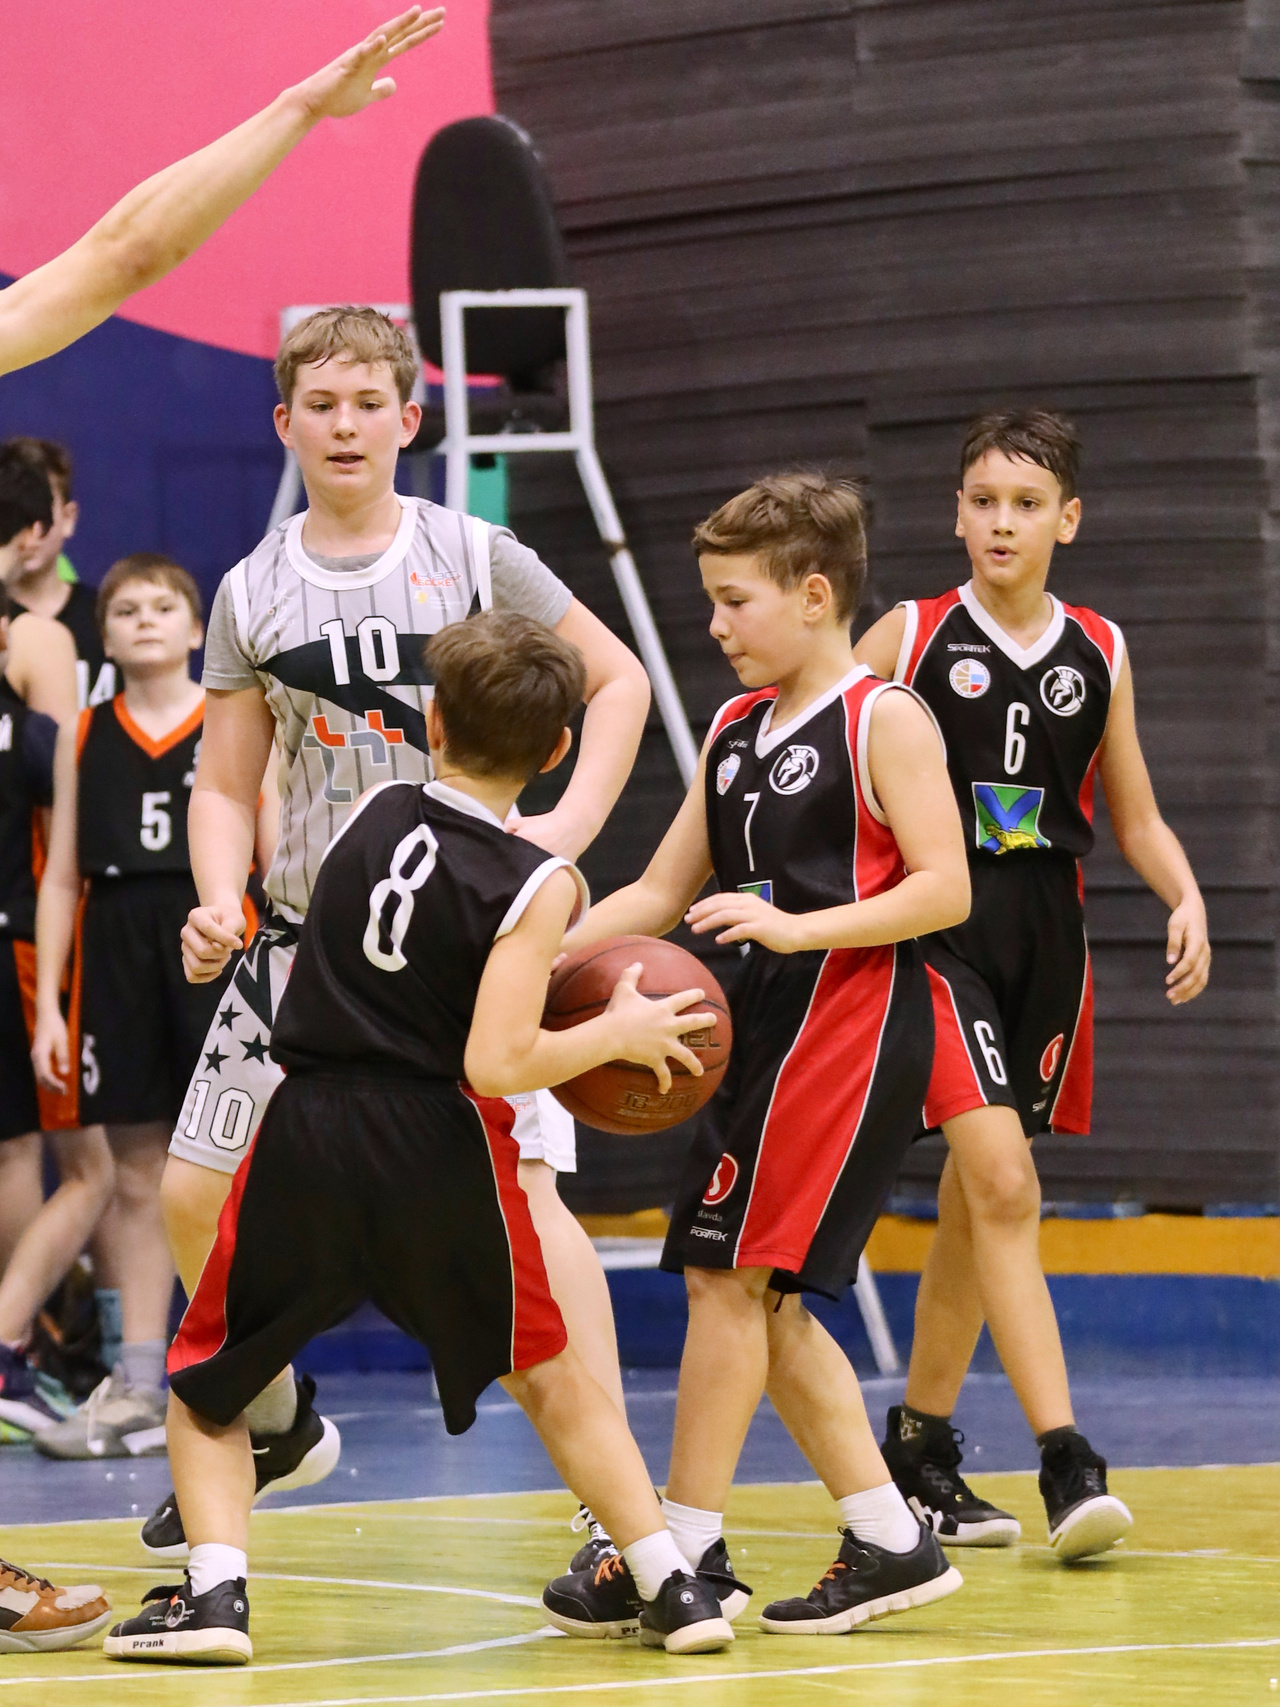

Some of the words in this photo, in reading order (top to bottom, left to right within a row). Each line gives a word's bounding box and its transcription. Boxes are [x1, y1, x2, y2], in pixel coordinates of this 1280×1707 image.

[320, 615, 401, 686] 10
[1004, 701, 1031, 776] 6
[140, 791, 171, 851] 5
[743, 791, 761, 872] 7
[362, 822, 440, 973] 8
[81, 1033, 100, 1096] 5
[973, 1019, 1009, 1086] 6
[184, 1080, 256, 1152] 10
[132, 1639, 165, 1649] Prank
